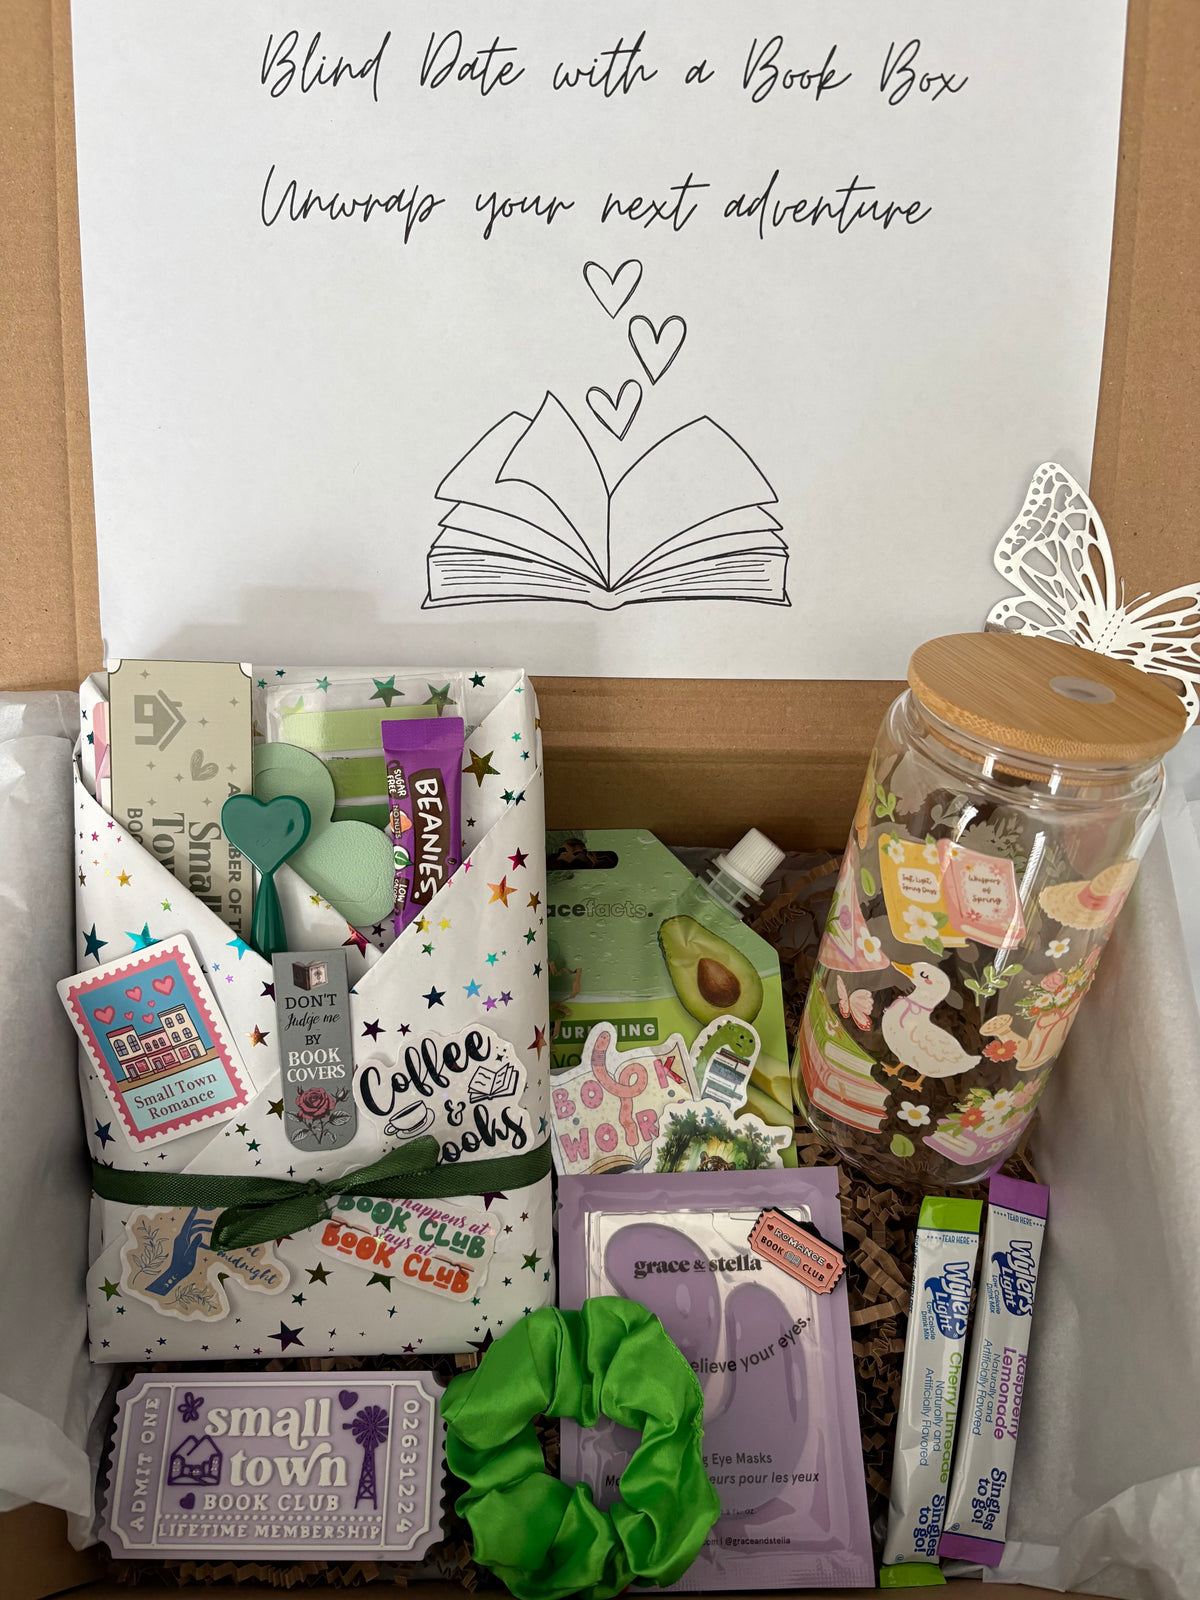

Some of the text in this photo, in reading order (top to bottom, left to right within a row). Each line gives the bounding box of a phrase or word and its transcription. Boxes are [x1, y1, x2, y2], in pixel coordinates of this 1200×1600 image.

[261, 30, 968, 106] Blind Date with a Book Box
[261, 164, 932, 244] Unwrap your next adventure
[387, 775, 397, 794] FREE
[393, 768, 407, 797] SUGAR
[228, 888, 242, 914] OF
[396, 884, 407, 903] LOW
[547, 898, 653, 918] acefacts.
[285, 993, 337, 1010] DON'T
[323, 1011, 341, 1024] me
[288, 1047, 342, 1067] BOOK
[304, 1034, 322, 1046] BY
[133, 1073, 217, 1109] Small Town
[286, 1064, 346, 1083] COVERS
[359, 1030, 491, 1116] Coffee
[148, 1088, 216, 1120] Romance
[444, 1099, 466, 1127] &
[437, 1103, 527, 1166] ooks
[560, 1108, 660, 1163] WOR
[418, 1218, 486, 1258] CLUB
[468, 1221, 492, 1236] at
[942, 1234, 970, 1245] TEAR HERE
[1007, 1212, 1033, 1227] TEAR HERE
[321, 1222, 470, 1294] BOOK CLUB
[373, 1225, 437, 1256] stays at
[760, 1235, 825, 1282] BOOK CLUB
[774, 1227, 827, 1266] ROMANCE
[634, 1254, 762, 1279] grace & stella
[1000, 1266, 1016, 1307] Light
[933, 1292, 953, 1331] Light
[692, 1316, 812, 1374] elieve your eyes.
[944, 1352, 962, 1407] Cherry
[972, 1338, 993, 1436] Artificially Flavored
[985, 1353, 1001, 1423] Naturally and
[994, 1346, 1017, 1440] Lemonade
[1007, 1353, 1027, 1440] Raspberry
[205, 1397, 331, 1450] small
[920, 1367, 934, 1466] Artificially Flavored
[932, 1380, 945, 1452] Naturally and
[130, 1397, 161, 1532] ADMIT ONE
[230, 1441, 348, 1488] town
[396, 1400, 420, 1534] 02631224
[712, 1453, 733, 1468] Eye
[736, 1451, 773, 1465] Masks
[739, 1474, 768, 1487] pour
[771, 1471, 789, 1483] les
[791, 1472, 820, 1486] yeux
[203, 1493, 340, 1512] BOOK CLUB
[971, 1478, 990, 1524] to go!
[983, 1467, 1007, 1531] Singles
[158, 1522, 381, 1540] LIFETIME MEMBERSHIP
[913, 1506, 931, 1553] to go!
[926, 1494, 946, 1557] Singles
